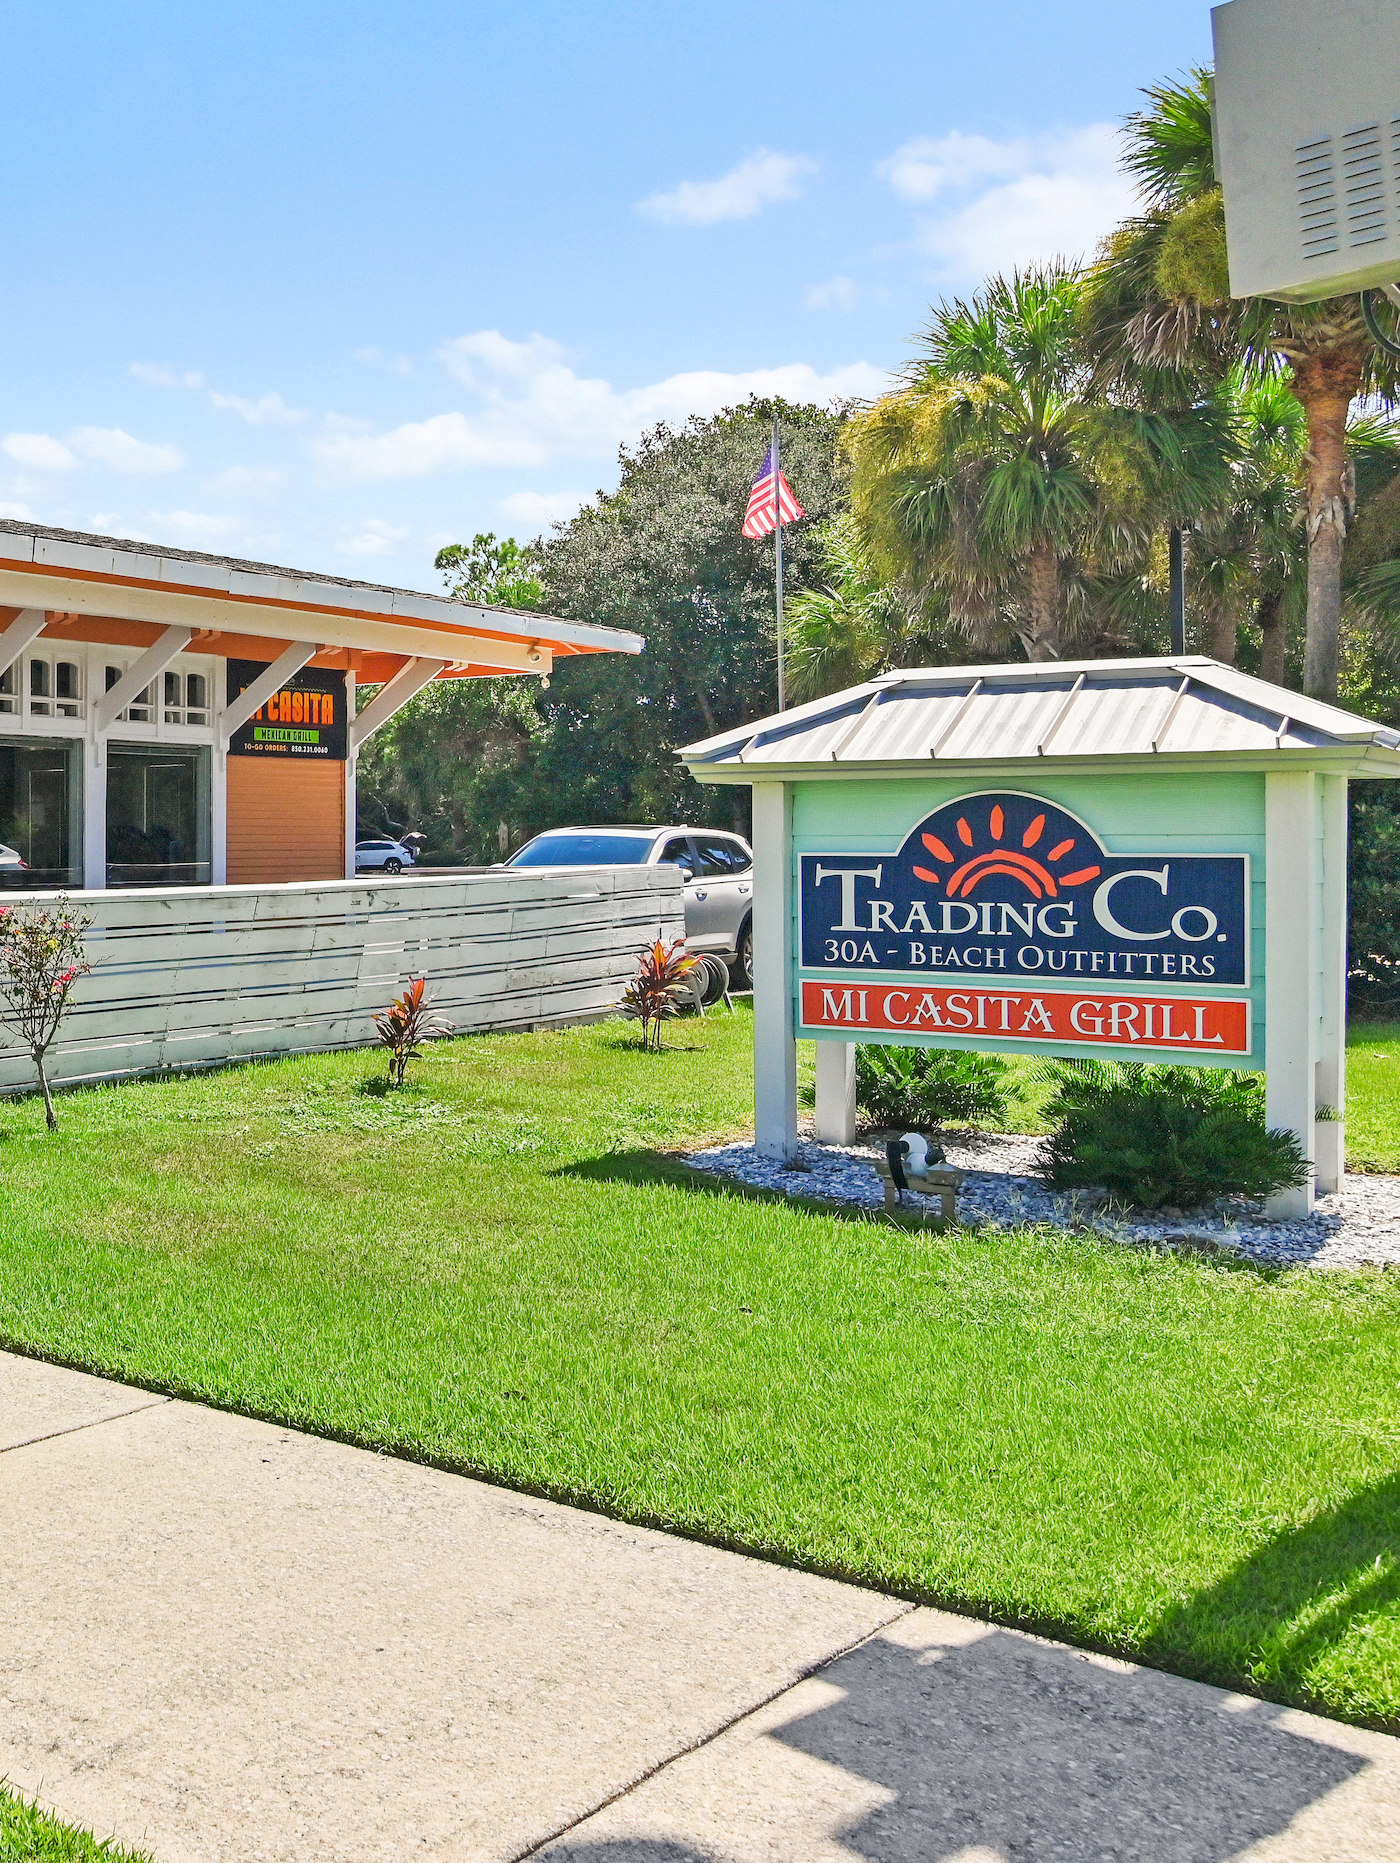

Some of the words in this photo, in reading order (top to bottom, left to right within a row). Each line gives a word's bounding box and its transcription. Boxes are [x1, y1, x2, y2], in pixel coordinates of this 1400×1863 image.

[267, 691, 334, 725] CASITA
[244, 743, 263, 751] TO-GO
[265, 743, 288, 752] ORDERS:
[291, 745, 328, 754] 850.231.0060
[261, 729, 291, 741] MEXICAN
[293, 730, 312, 742] GRILL
[824, 939, 880, 964] 30A
[908, 941, 1006, 969] BEACH
[1017, 944, 1216, 977] OUTFITTERS
[820, 988, 869, 1022] MI
[883, 991, 1056, 1033] CASITA
[1070, 1000, 1225, 1044] GRILL
